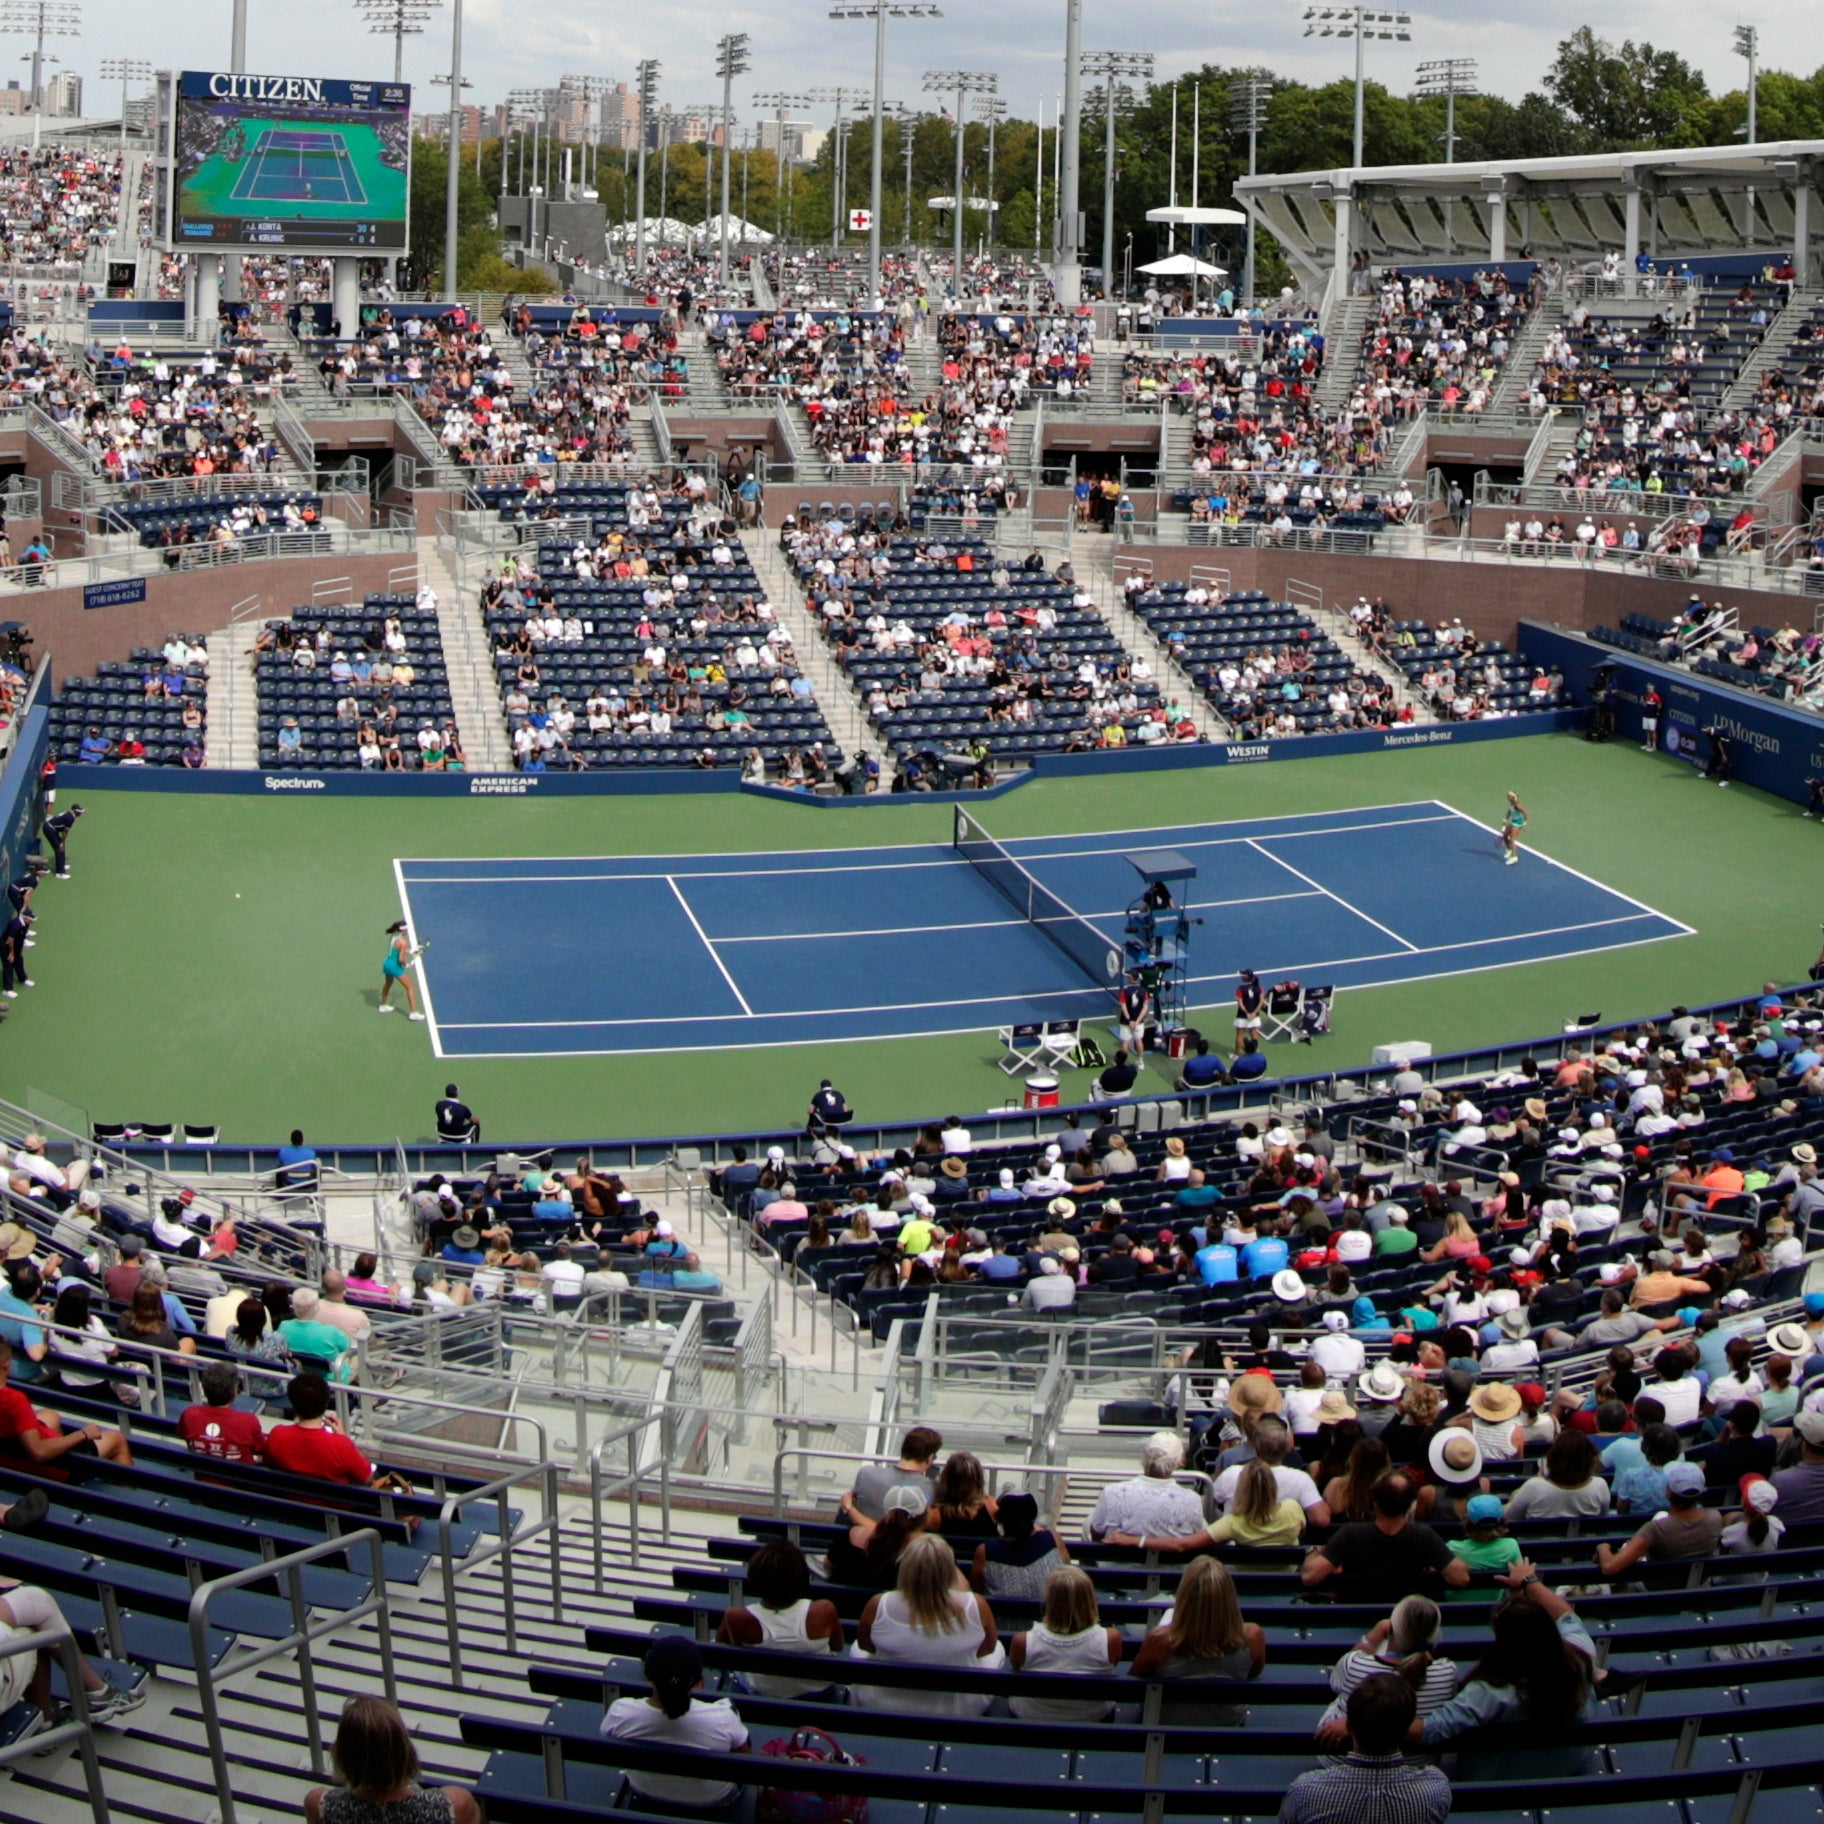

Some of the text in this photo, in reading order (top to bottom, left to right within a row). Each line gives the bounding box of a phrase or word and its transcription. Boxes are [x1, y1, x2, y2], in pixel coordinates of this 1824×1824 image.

[1384, 731, 1453, 746] Mercedes-Benz
[1713, 713, 1780, 754] JPMorgan
[1226, 745, 1270, 757] WESTIN
[264, 776, 321, 791] Spectrum
[470, 777, 538, 786] AMERICAN
[470, 785, 527, 793] EXPRESS
